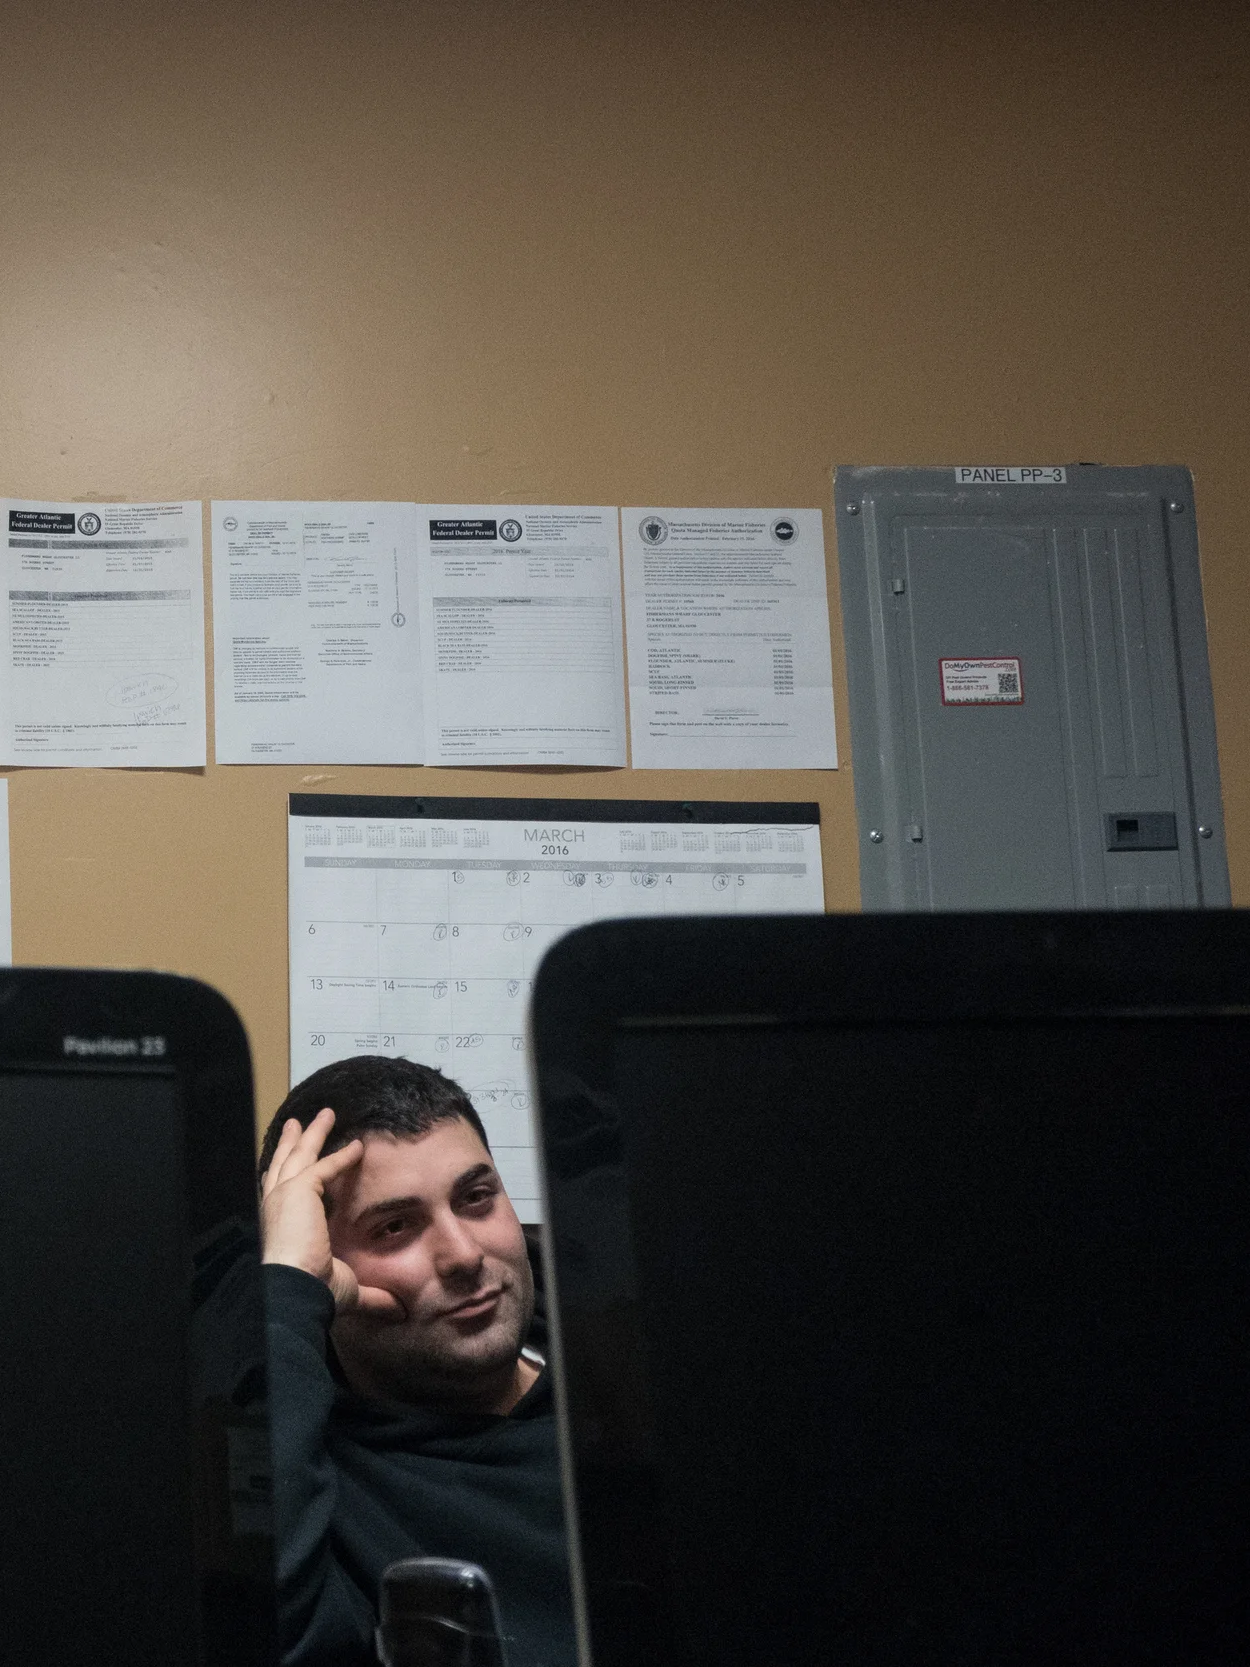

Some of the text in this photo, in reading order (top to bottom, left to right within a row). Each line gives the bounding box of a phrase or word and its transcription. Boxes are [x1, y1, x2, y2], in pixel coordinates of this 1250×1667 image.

[960, 468, 1063, 483] PANEL PP-3
[16, 512, 62, 521] Greater Atlantic
[432, 529, 454, 537] Federal
[944, 661, 1015, 670] DoMyOwnPestControl
[523, 828, 586, 843] MARCH
[541, 844, 570, 856] 2016
[324, 858, 791, 873] SUNDAY MONDAY TUESDAY WEDNESDAY THURSDAY FRIDAY SATURDAY
[451, 871, 745, 887] 1 2 3 4 5
[308, 924, 533, 937] 6 7 8 9
[310, 978, 323, 990] 13
[382, 979, 395, 992] 14
[454, 980, 468, 993] 15
[63, 1034, 139, 1056] Pavilion
[310, 1034, 326, 1047] 20
[382, 1035, 396, 1048] 21
[455, 1036, 470, 1049] 22
